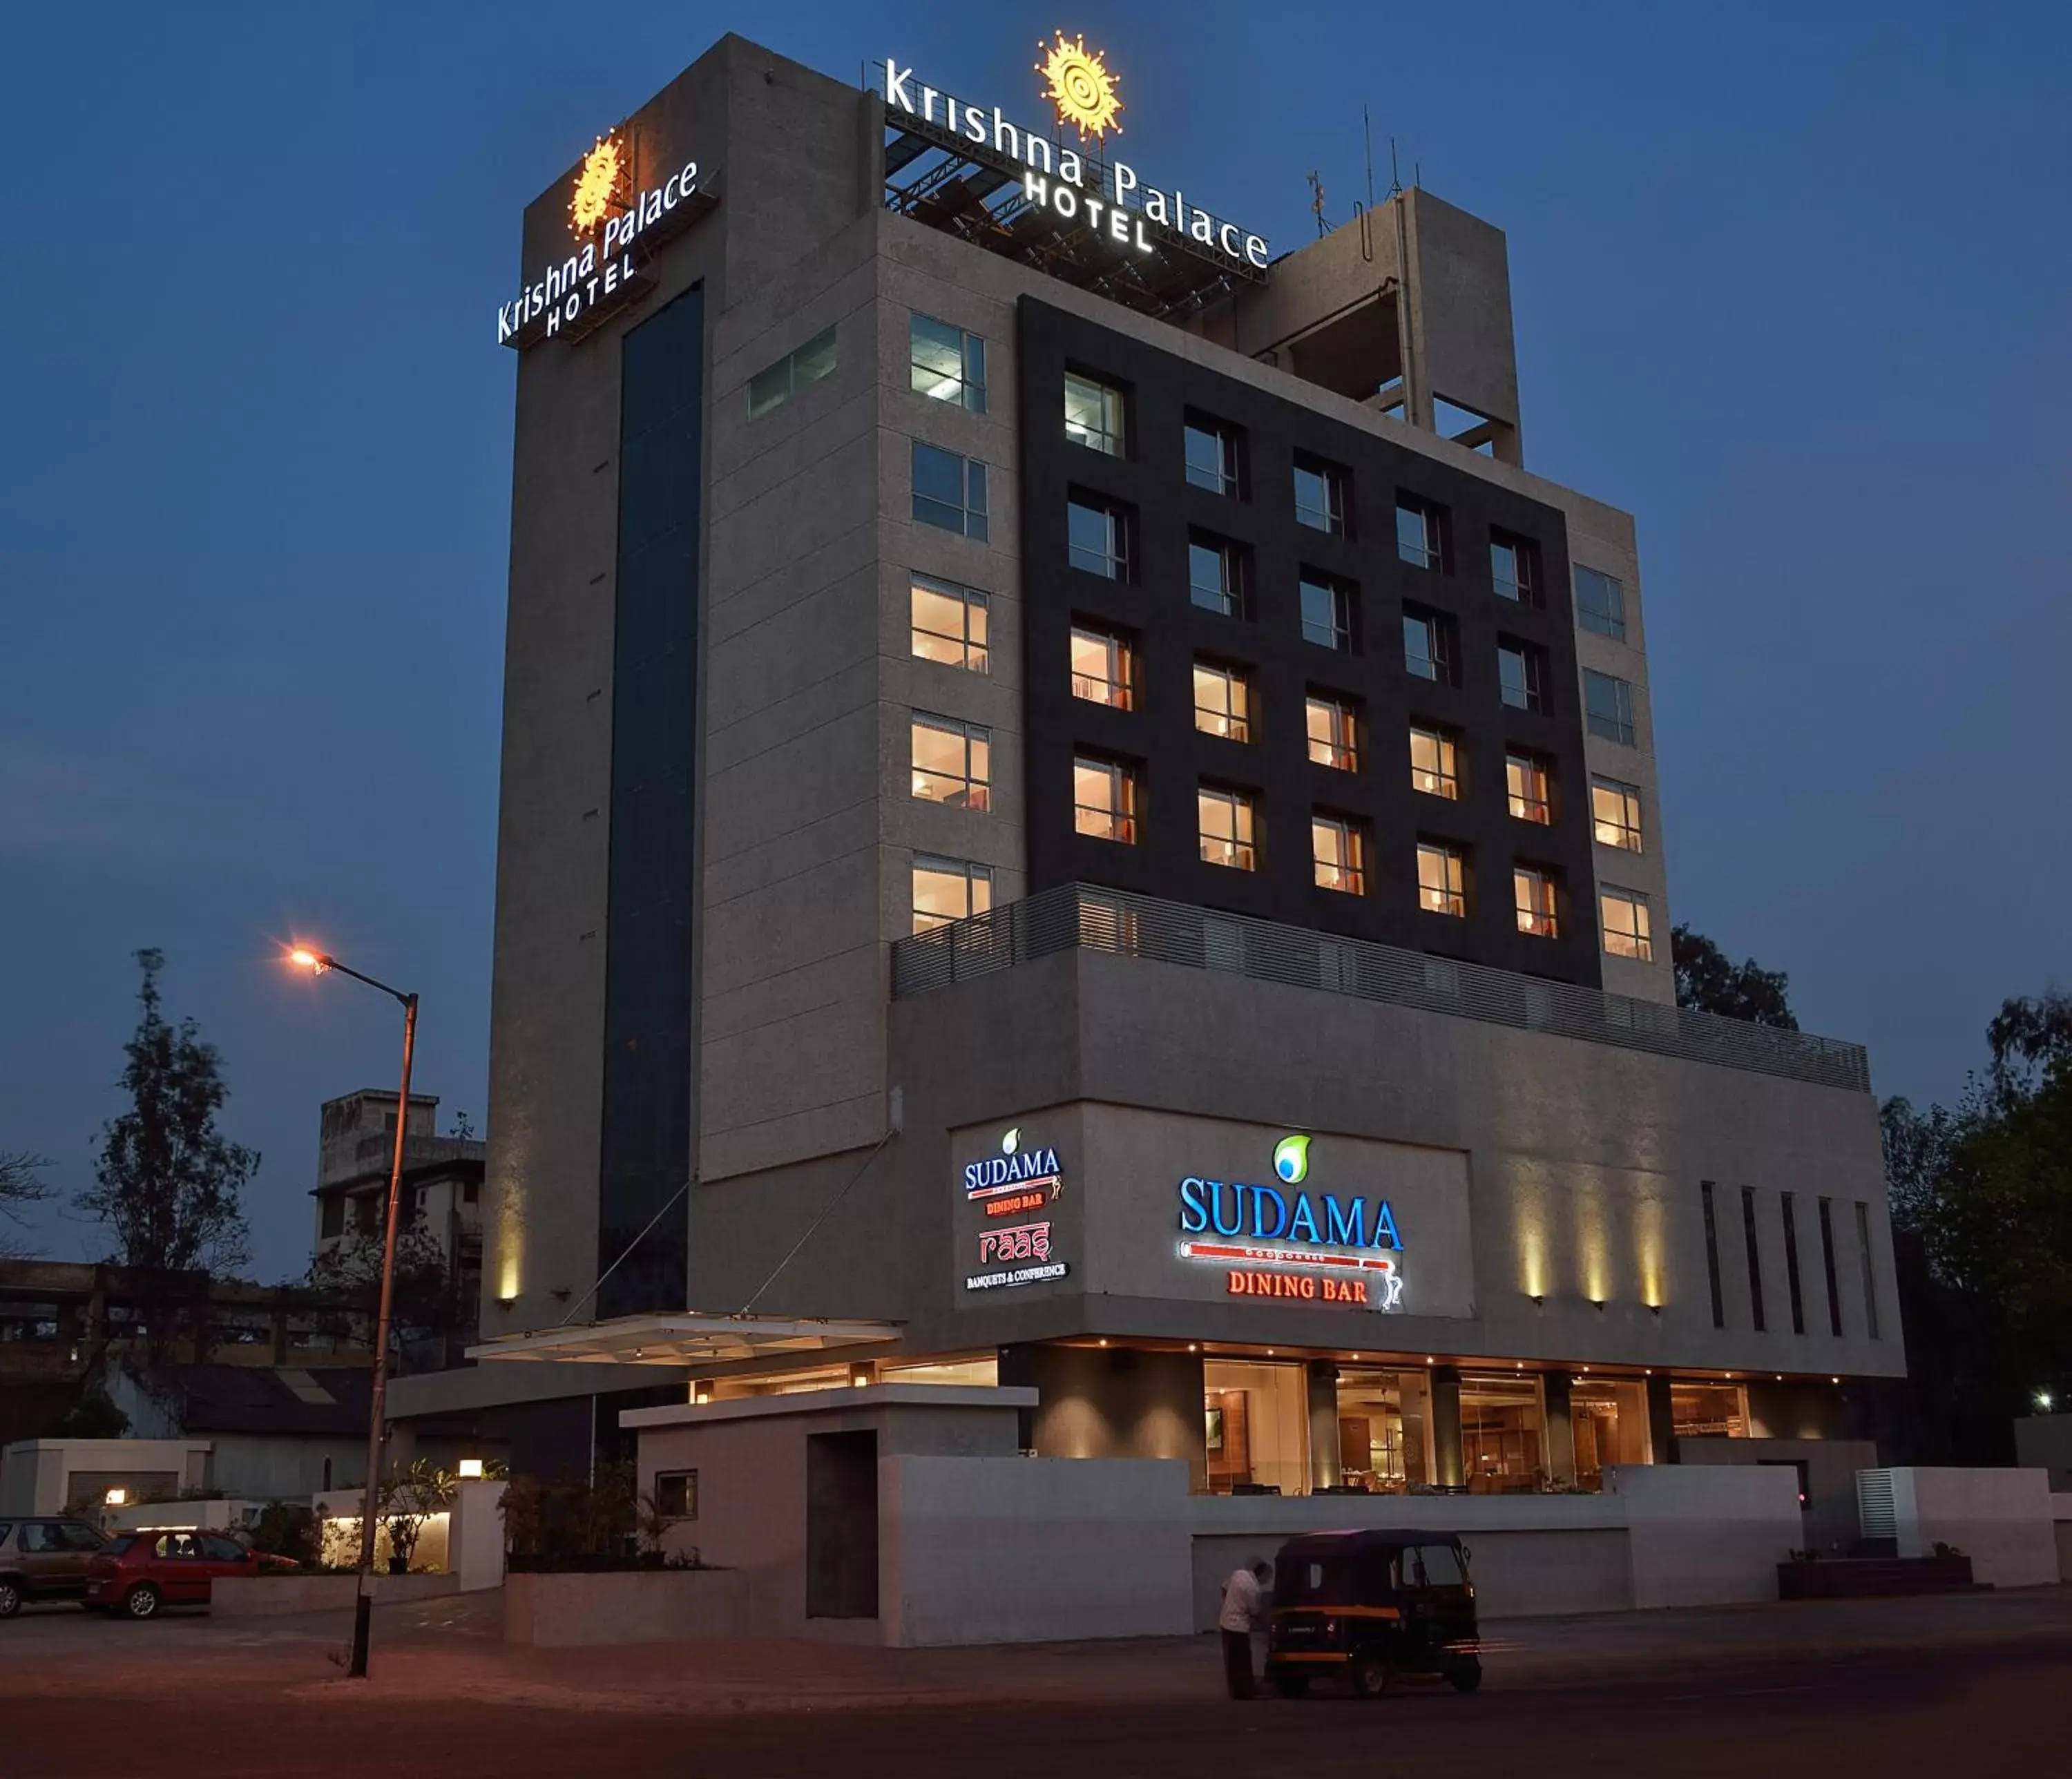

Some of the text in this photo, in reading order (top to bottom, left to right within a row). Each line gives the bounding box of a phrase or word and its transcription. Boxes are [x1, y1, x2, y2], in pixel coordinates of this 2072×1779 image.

[886, 59, 1269, 269] Krishna Palace
[1025, 172, 1153, 253] HOTEL
[497, 162, 698, 343] Krishna Palace
[546, 253, 635, 337] HOTEL
[966, 1148, 1059, 1189] SUDAMA
[987, 1193, 1043, 1215] DINING BAR
[1180, 1177, 1403, 1251] SUDAMA
[967, 1263, 1066, 1289] BANQUETS & CONFERENCE
[1228, 1270, 1368, 1302] DINING BAR
